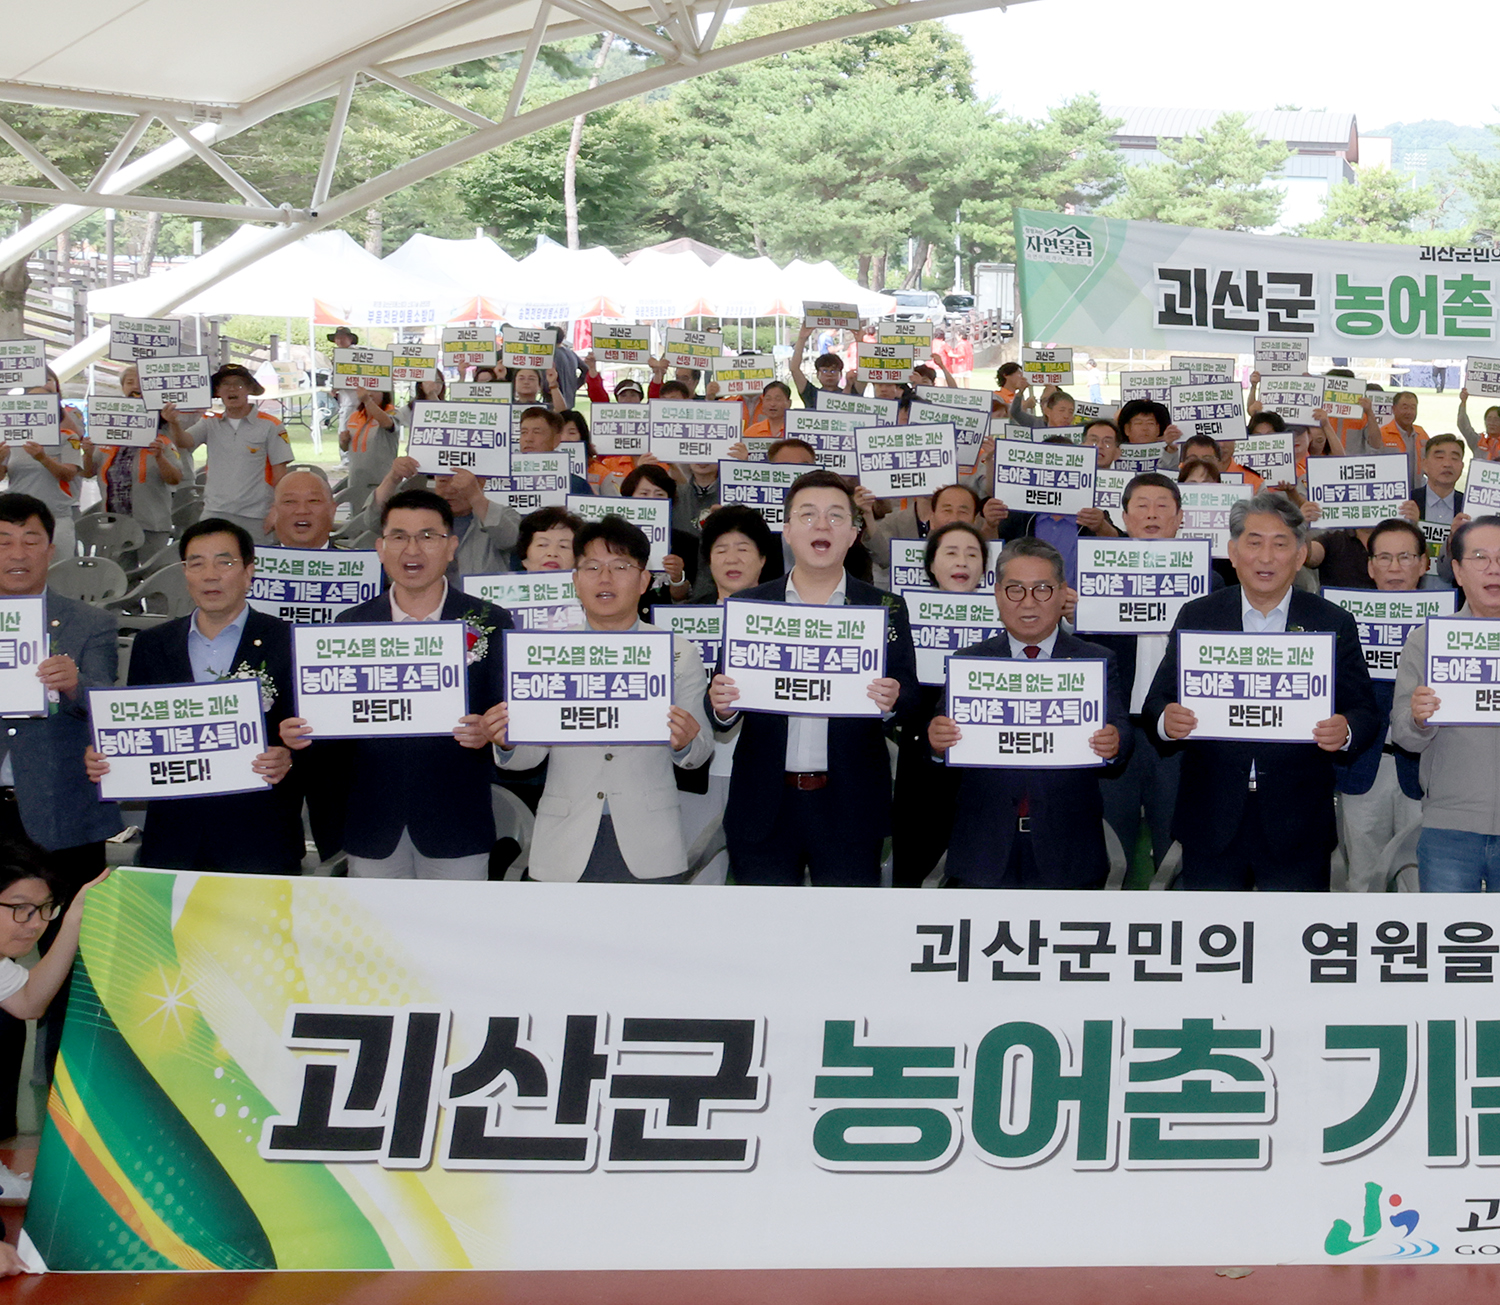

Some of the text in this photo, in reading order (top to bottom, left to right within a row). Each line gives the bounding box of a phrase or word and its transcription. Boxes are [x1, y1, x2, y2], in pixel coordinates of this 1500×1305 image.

[1026, 235, 1092, 257] 자연울림
[1157, 267, 1317, 333] 괴산군
[1337, 273, 1491, 337] 농어촌
[609, 327, 631, 337] 괴산군
[351, 352, 373, 363] 괴산군
[605, 350, 638, 360] 선정 기원!
[874, 346, 895, 356] 괴산군
[1035, 351, 1054, 360] 괴산군
[345, 376, 379, 387] 선정 기원!
[868, 370, 901, 380] 선정 기원!
[1032, 373, 1061, 383] 선정 기원!
[423, 410, 497, 425] 인구소멸 없는 괴산
[413, 427, 506, 448] 농어촌 기본 소득이
[868, 431, 942, 448] 인구소멸 없는 괴산
[438, 450, 475, 468] 만든다!
[861, 449, 952, 470] 농어촌 기본 소득이
[890, 472, 925, 488] 만든다!
[1447, 631, 1500, 650] 인구소멸
[527, 645, 651, 665] 인구소멸 없는 괴산
[1432, 657, 1482, 682] 농어촌
[513, 673, 666, 699] 농어촌 기본 소득이
[968, 671, 1085, 692] 인구소멸 없는 괴산
[110, 694, 239, 722] 인구소멸 없는 괴산
[561, 706, 618, 729] 만든다!
[954, 698, 1098, 724] 농어촌 기본 소득이
[99, 722, 258, 756] 농어촌 기본 소득이
[999, 731, 1053, 754] 만든다!
[150, 758, 211, 784] 만든다!
[910, 918, 1255, 984] 괴산군민의
[1301, 920, 1500, 984] 염원을
[265, 1010, 763, 1165] 괴산군
[810, 1017, 1270, 1165] 농어촌
